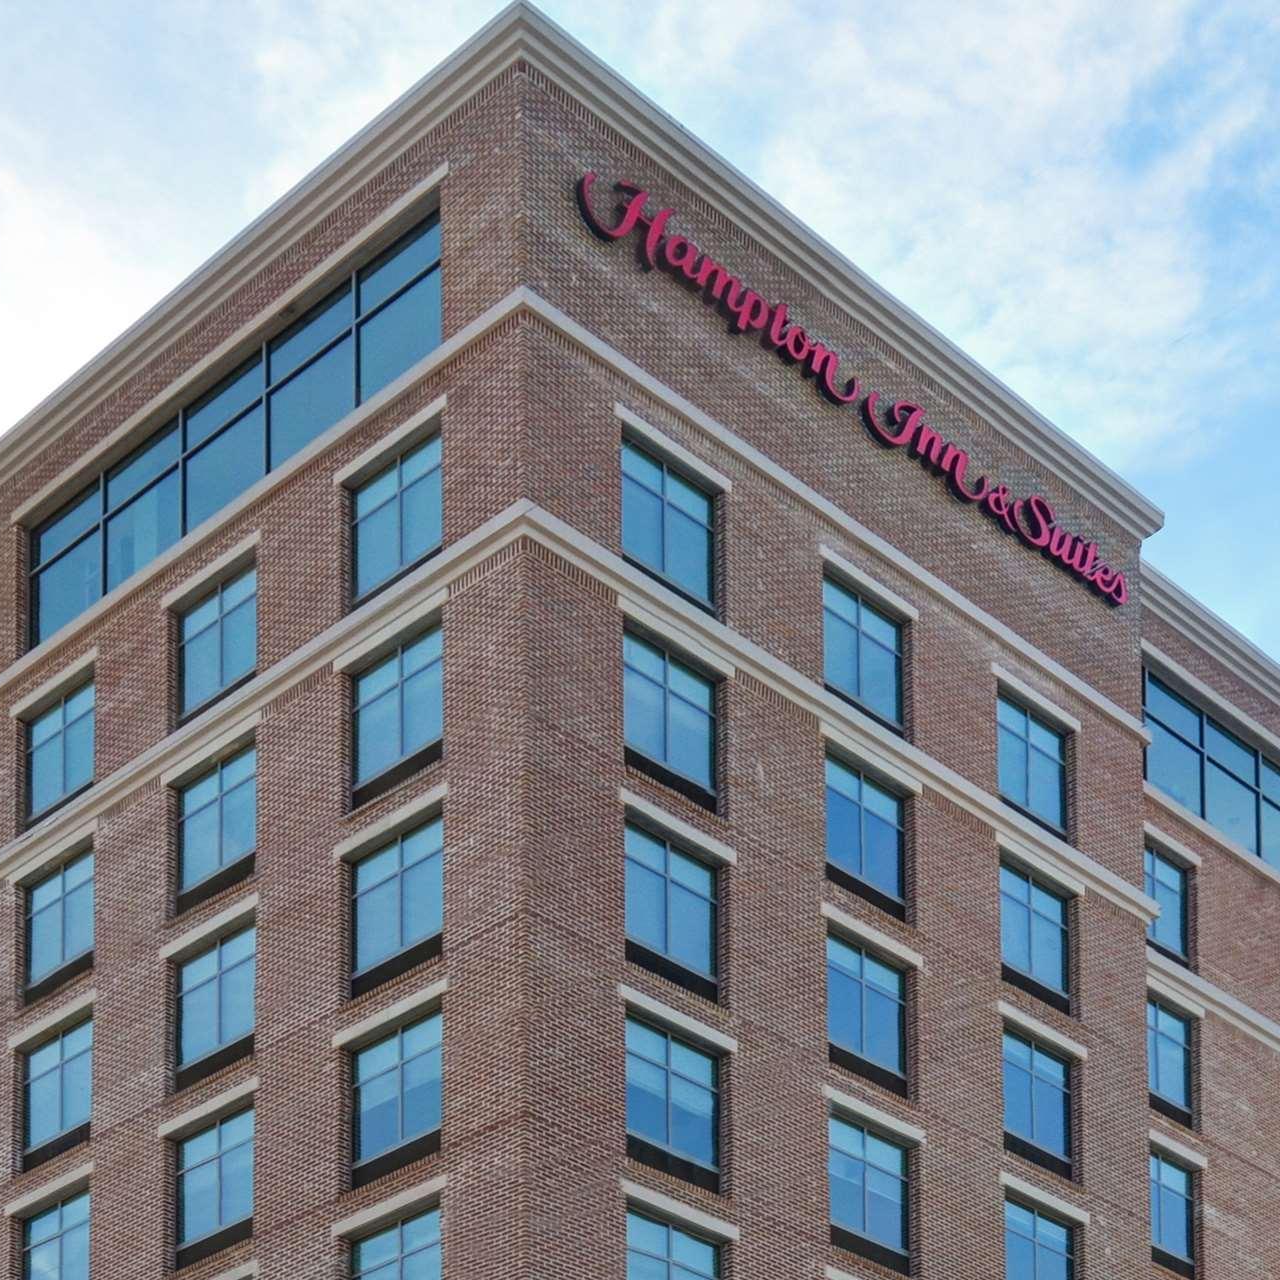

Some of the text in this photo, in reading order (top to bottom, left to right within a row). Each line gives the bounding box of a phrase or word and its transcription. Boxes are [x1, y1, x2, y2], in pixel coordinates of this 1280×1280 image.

[578, 171, 1129, 605] Hampton Inn & Suites
